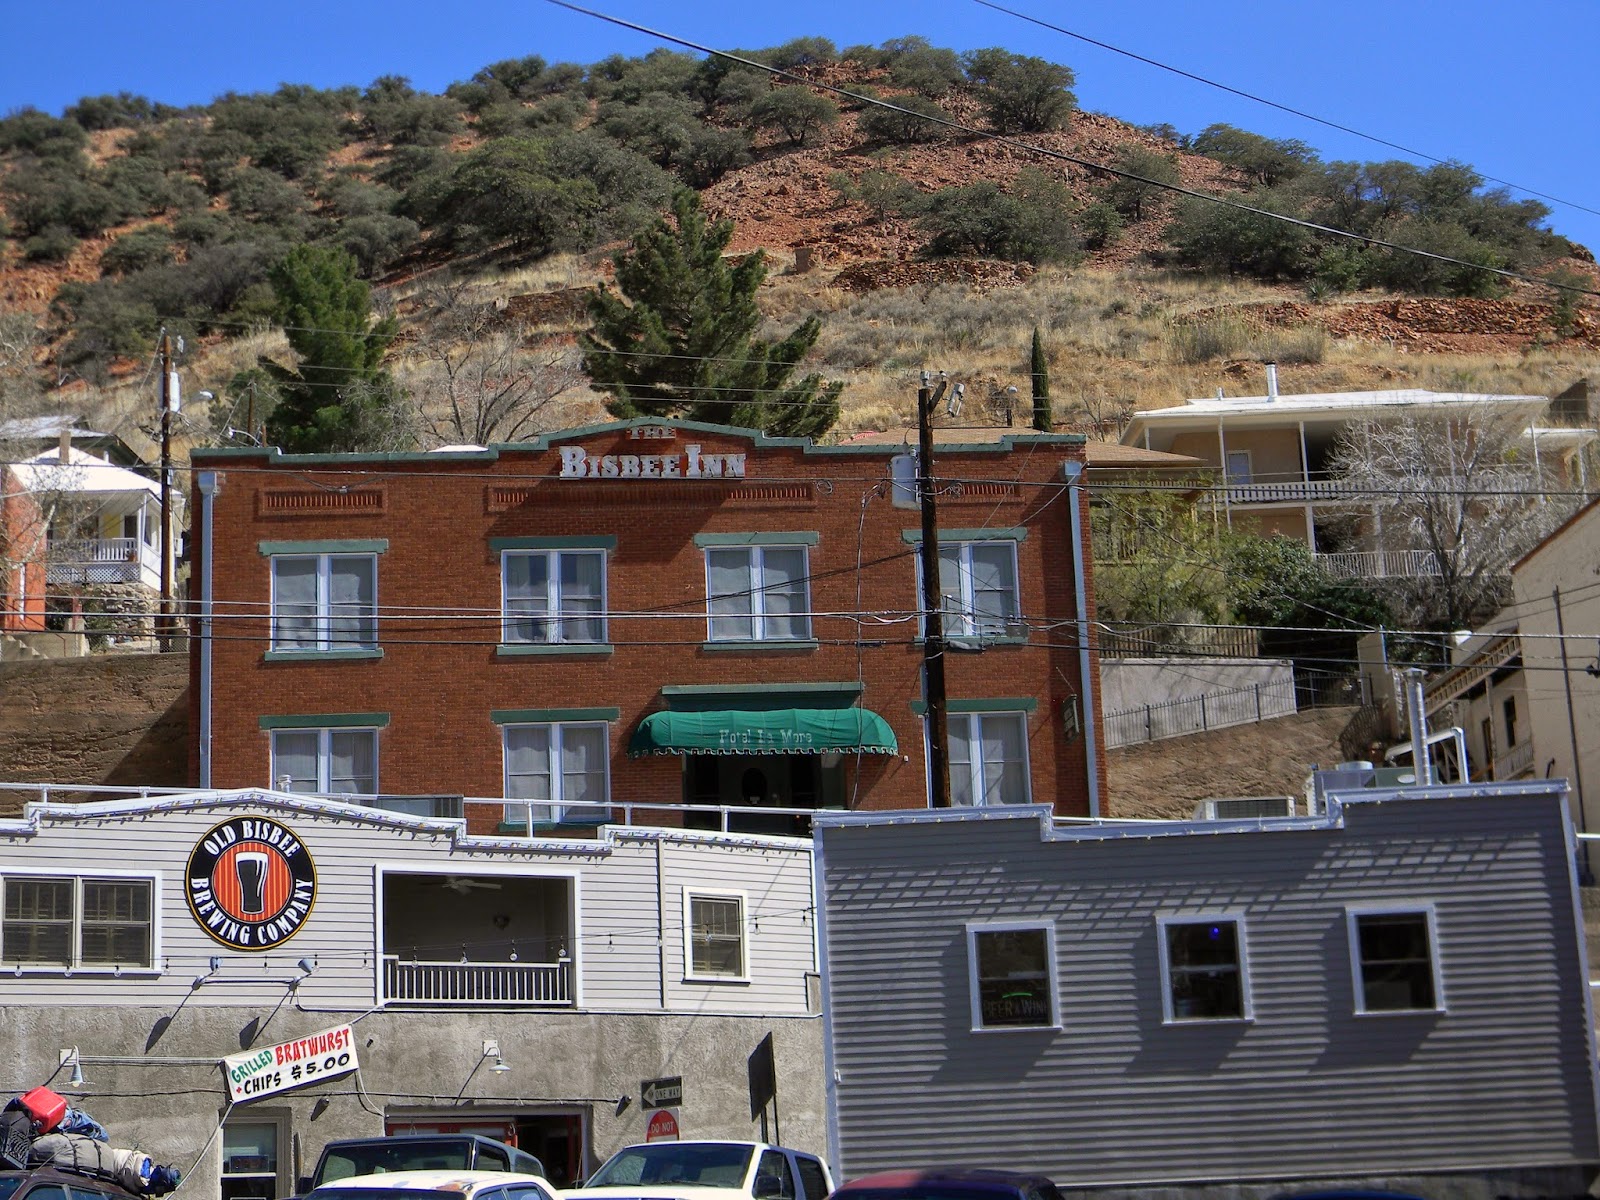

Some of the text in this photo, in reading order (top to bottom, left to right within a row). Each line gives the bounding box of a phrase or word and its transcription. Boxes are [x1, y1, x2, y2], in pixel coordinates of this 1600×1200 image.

[627, 426, 676, 439] THE
[559, 444, 746, 479] BISBEE INN
[780, 729, 813, 743] More
[203, 820, 301, 858] OLD BISBEE
[190, 877, 313, 945] BREWING COMPANY
[231, 1028, 349, 1084] GRILLED BRATWURST
[291, 1052, 350, 1081] $5.00
[656, 1087, 680, 1099] ONE WAY
[651, 1121, 674, 1134] DO NOT
